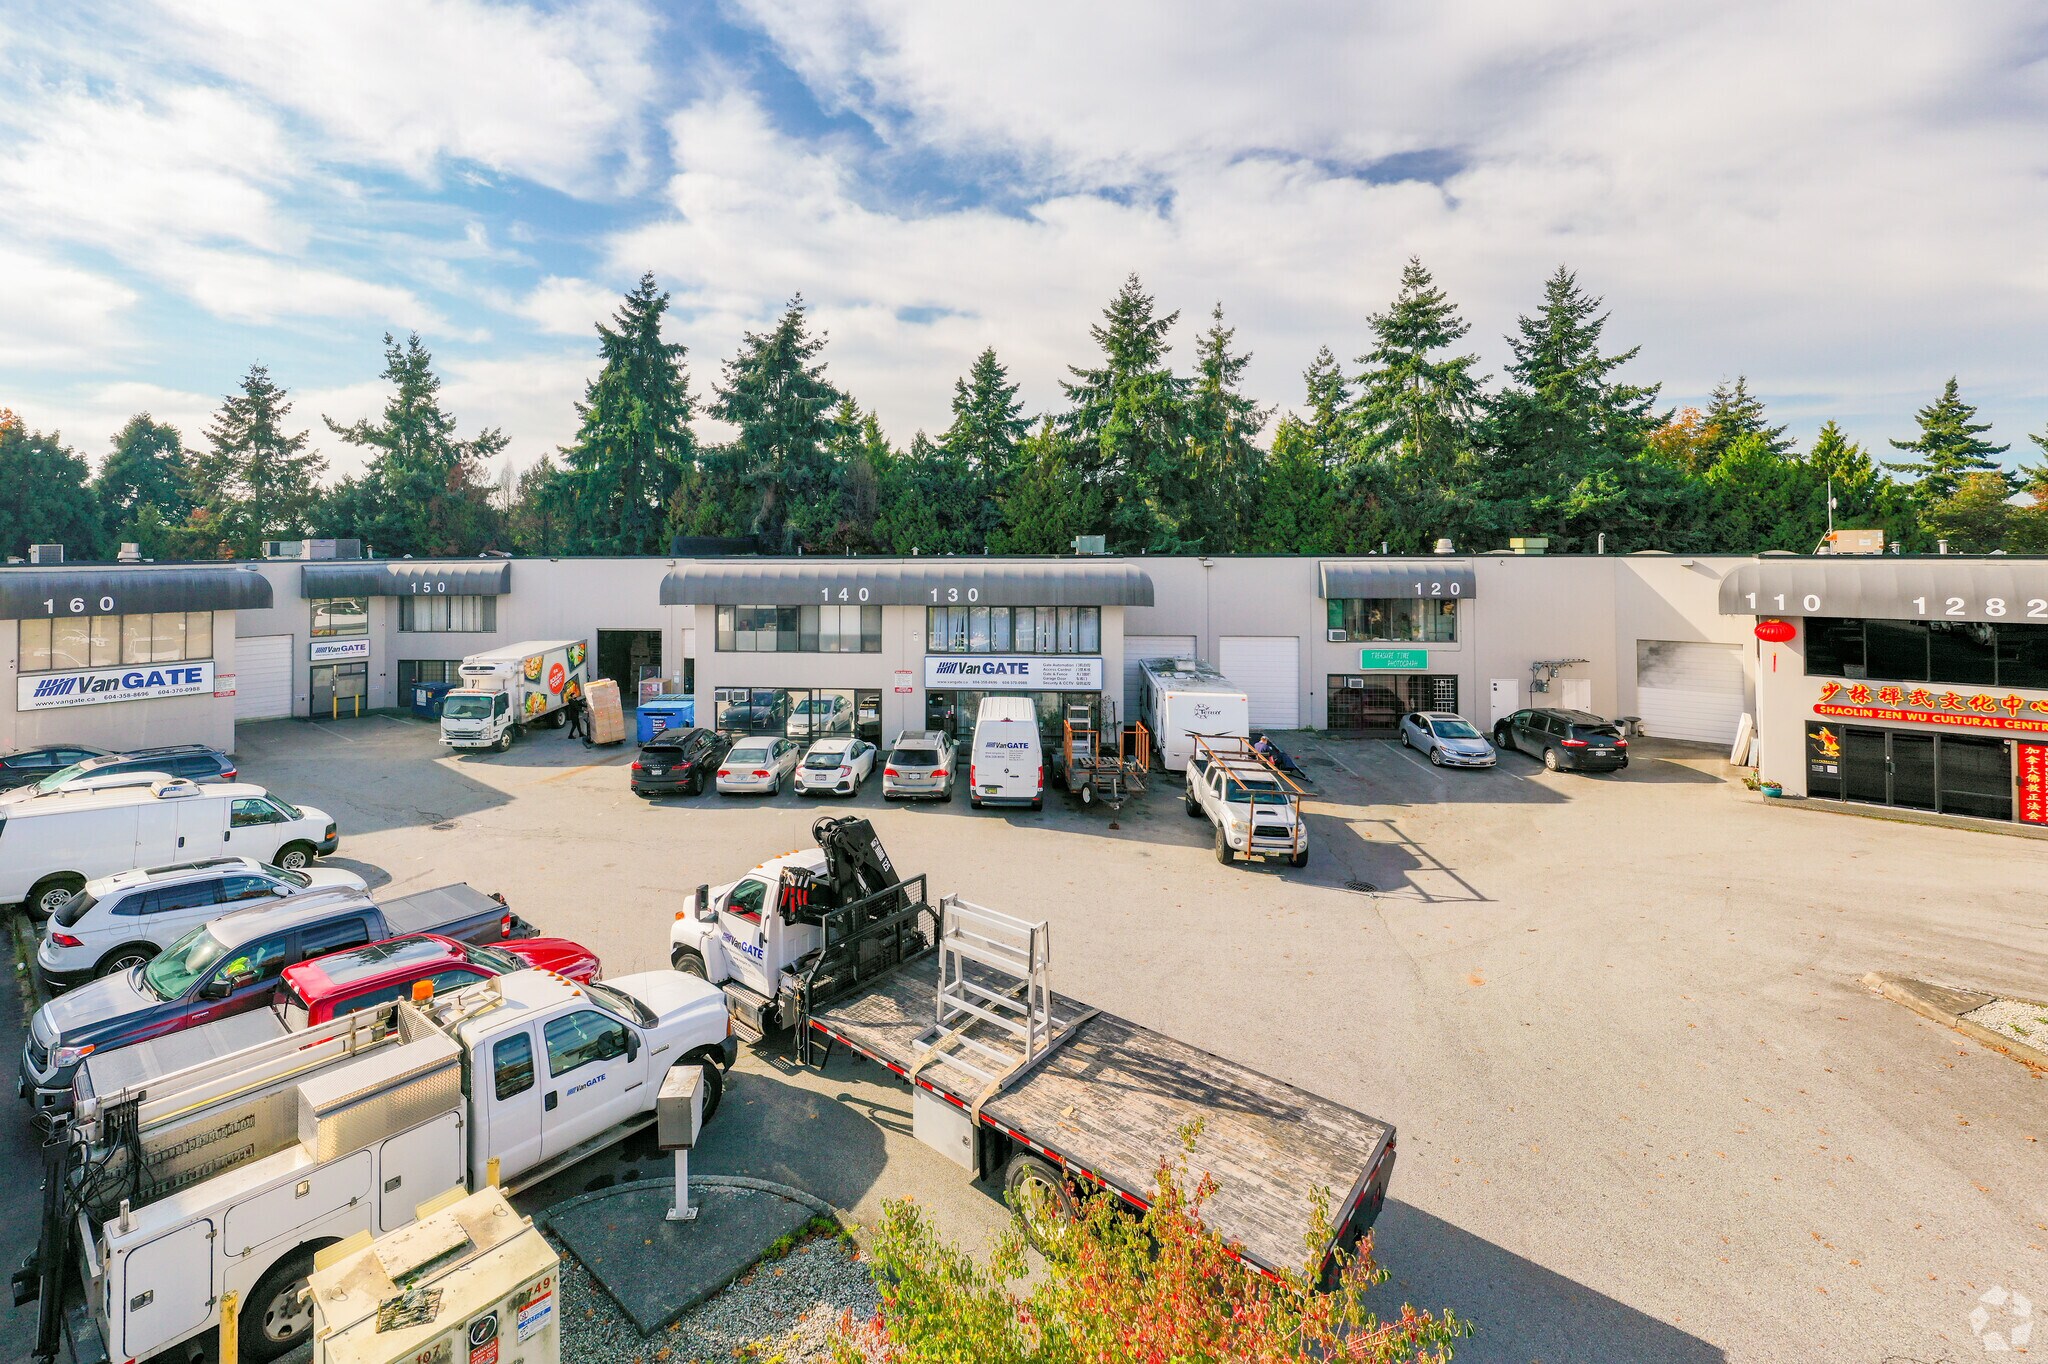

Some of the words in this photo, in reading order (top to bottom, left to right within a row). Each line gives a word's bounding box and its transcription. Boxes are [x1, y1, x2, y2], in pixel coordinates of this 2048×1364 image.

[411, 582, 446, 593] 150
[821, 587, 869, 602] 140
[931, 587, 979, 602] 130
[1415, 582, 1460, 595] 120
[44, 596, 114, 614] 160
[1745, 592, 1821, 611] 110
[1913, 597, 2048, 618] 1282
[35, 696, 96, 706] www.vangate.ca
[104, 691, 149, 700] 604-358-8696
[1820, 706, 1873, 718] SHAOLIN
[1878, 710, 1902, 720] ZEN
[1907, 712, 1927, 722] WU
[1932, 715, 1999, 727] CULTURAL
